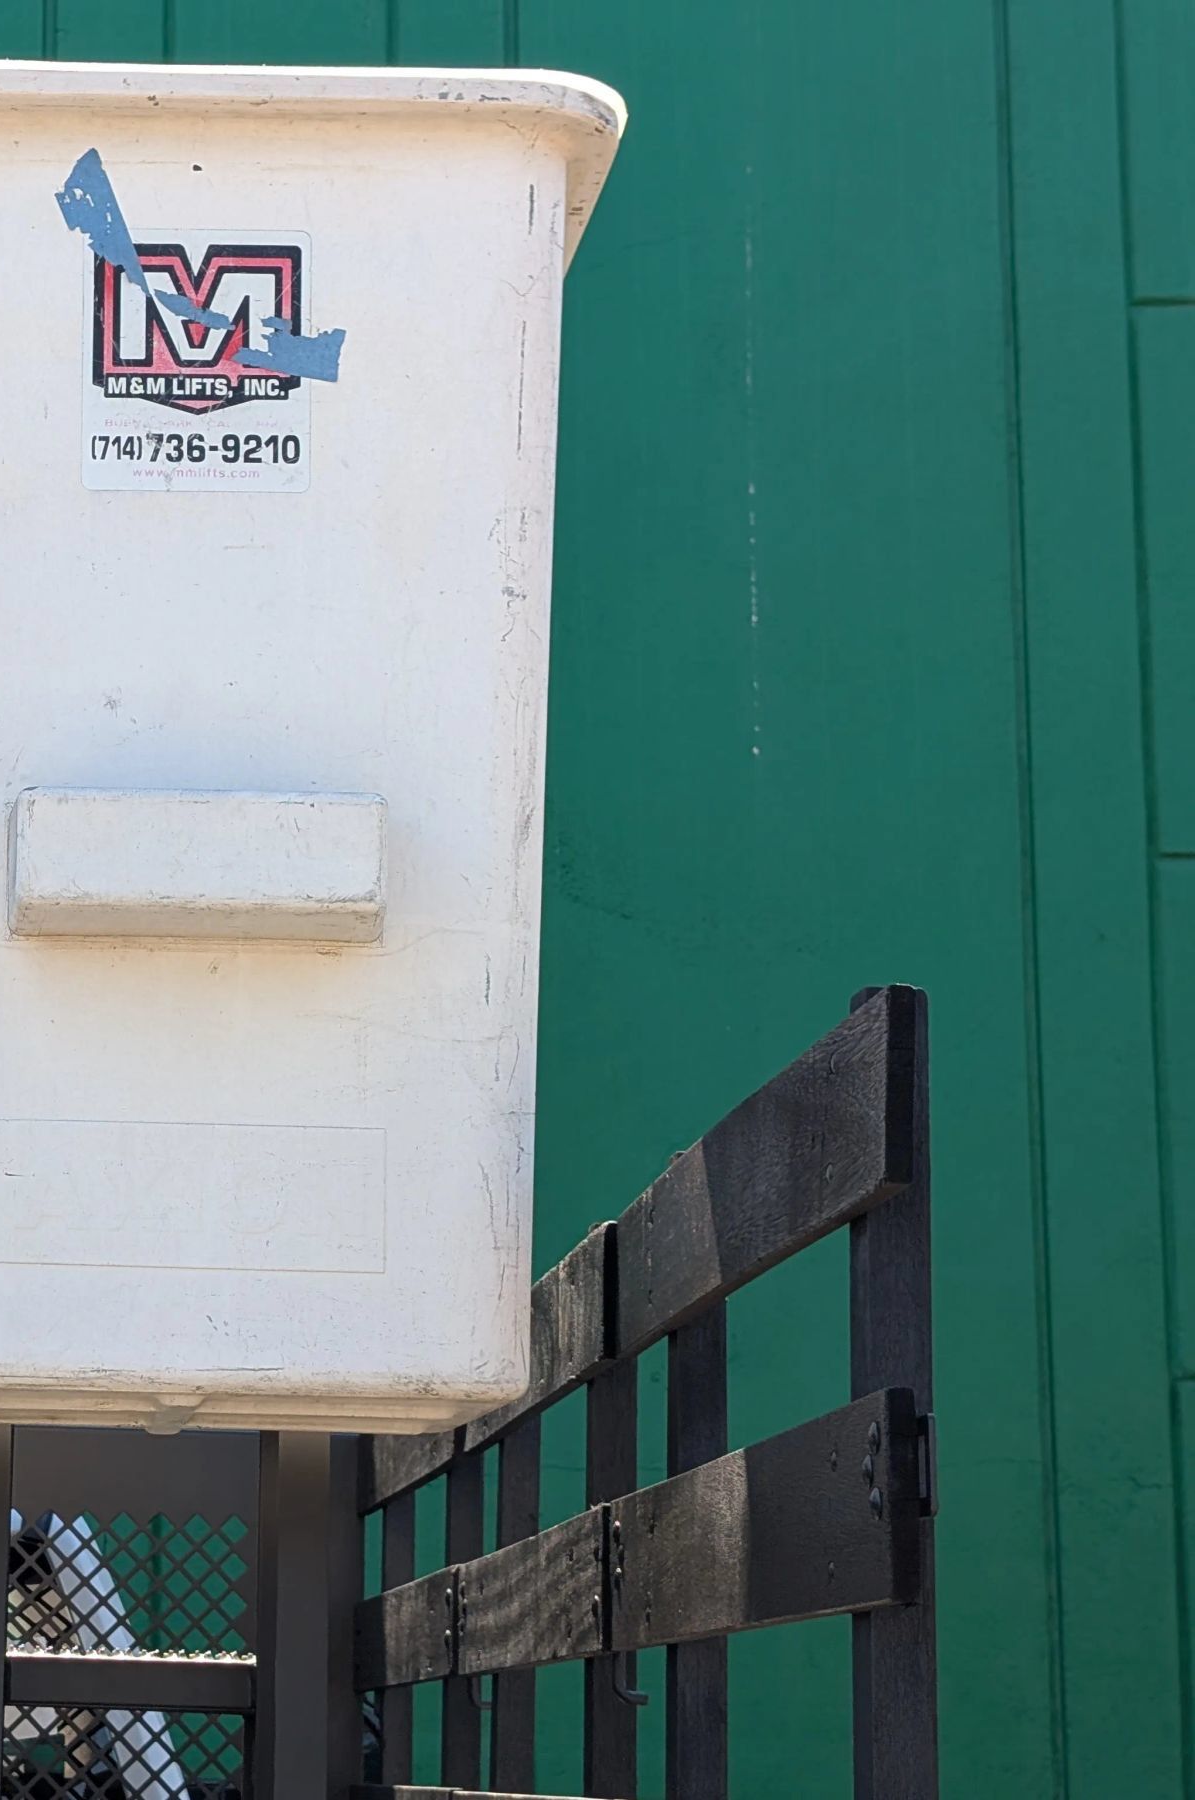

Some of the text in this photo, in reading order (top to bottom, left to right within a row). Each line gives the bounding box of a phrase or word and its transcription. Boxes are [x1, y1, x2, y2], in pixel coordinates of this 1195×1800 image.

[107, 376, 286, 398] M&M LIFTS, INC.
[132, 466, 260, 479] wwwmmlifts.com
